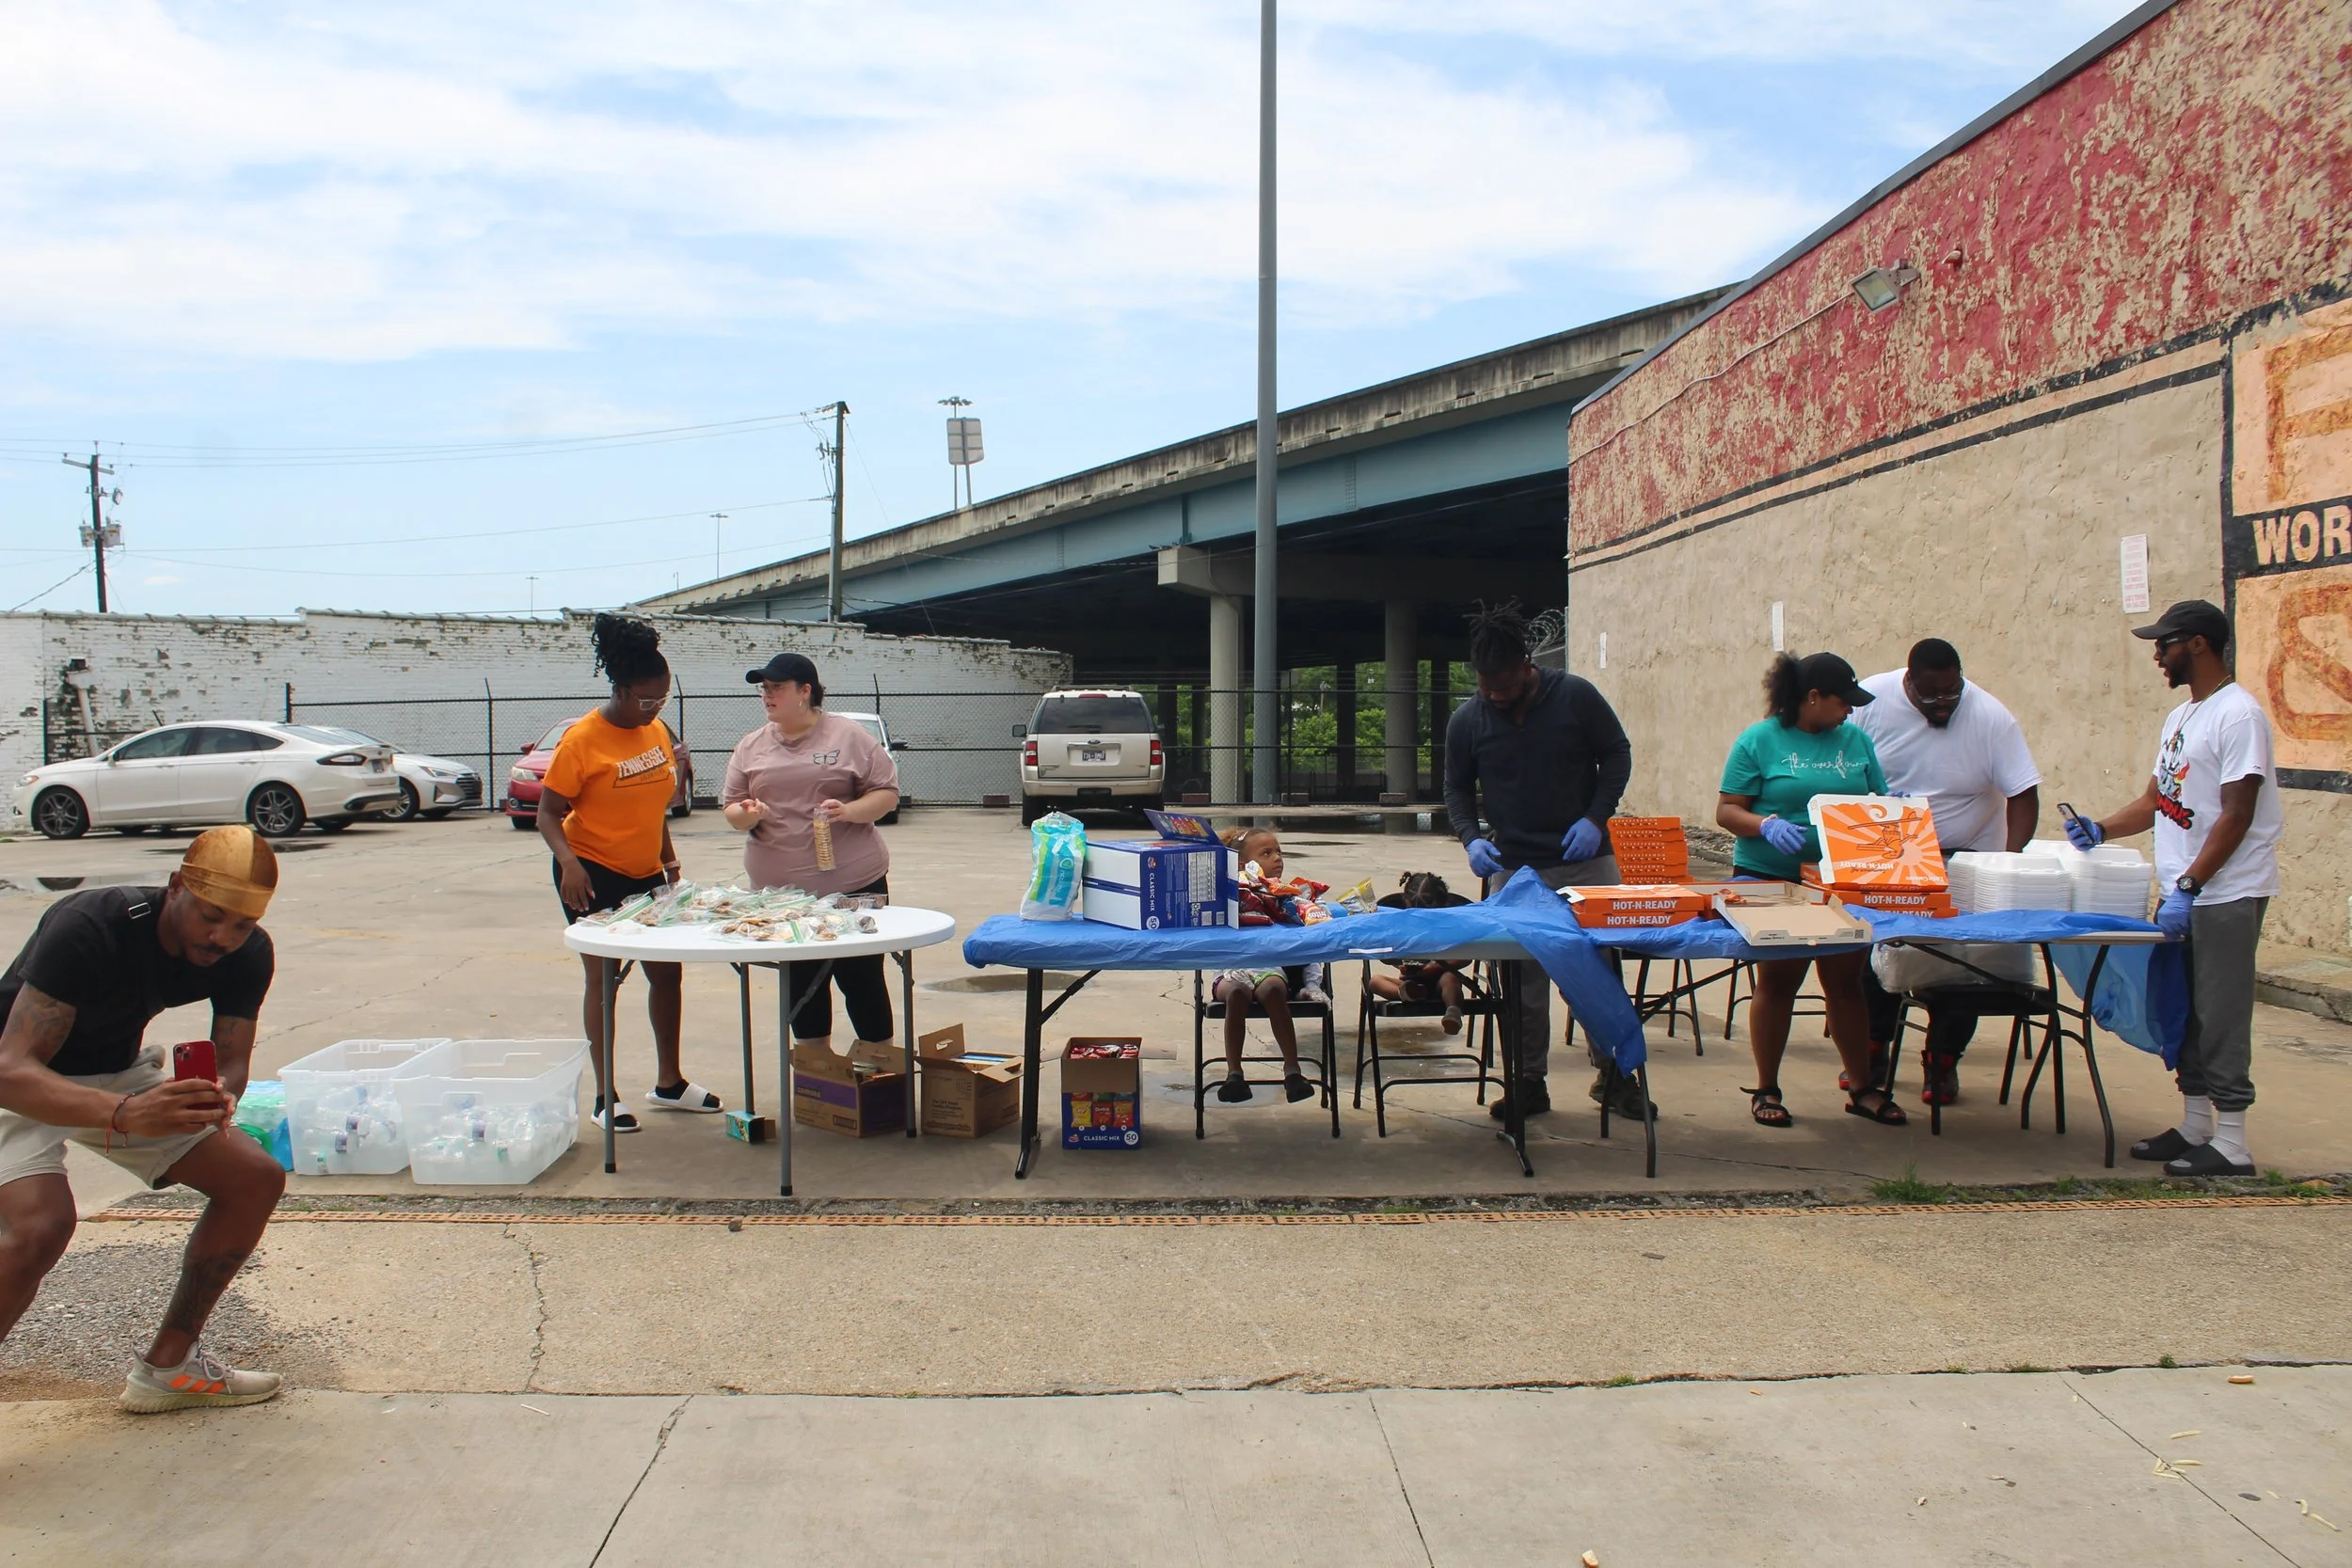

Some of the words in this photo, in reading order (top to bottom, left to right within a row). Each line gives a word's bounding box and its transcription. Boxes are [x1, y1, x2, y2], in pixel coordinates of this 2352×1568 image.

[2253, 504, 2352, 565] WOR
[615, 745, 667, 779] TENNESSEE
[1865, 895, 1926, 904] HOT-N-READY
[1613, 901, 1677, 910] HOT-N-READY
[1150, 917, 1157, 929] 50
[1607, 916, 1671, 925] HOT-N-READY
